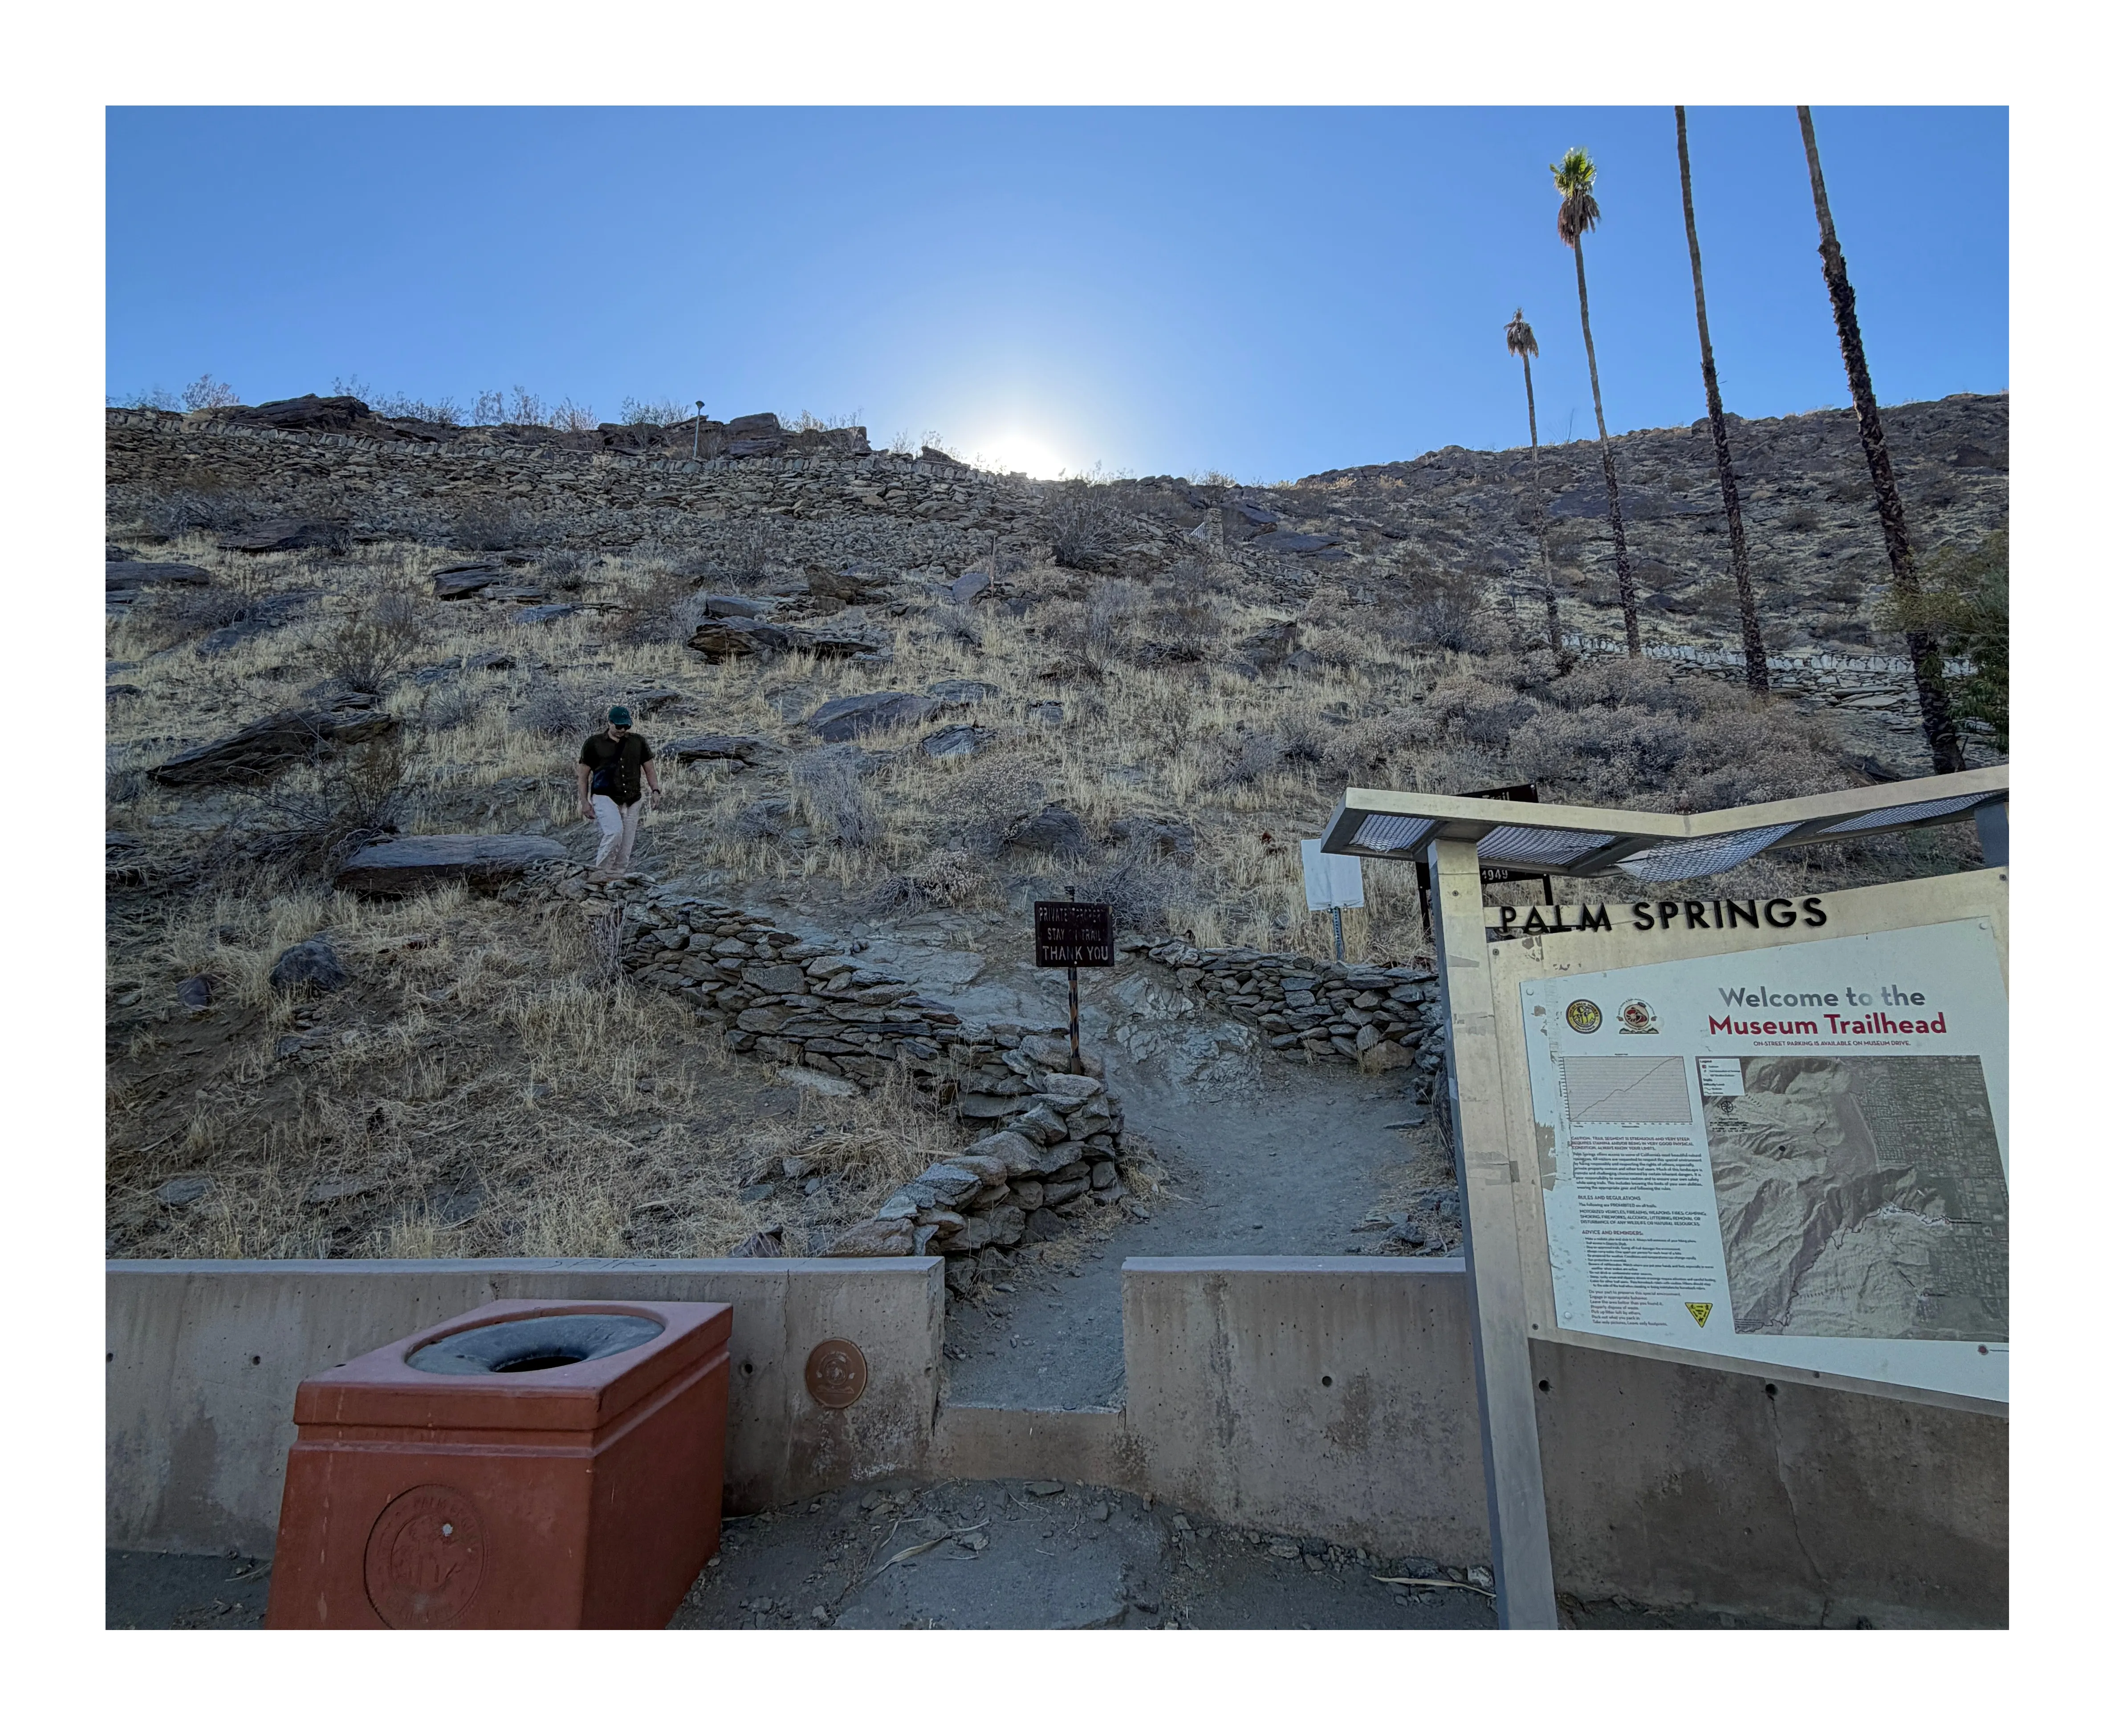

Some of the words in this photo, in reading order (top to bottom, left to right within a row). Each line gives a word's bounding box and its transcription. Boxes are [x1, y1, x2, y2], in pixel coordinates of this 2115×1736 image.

[1039, 907, 1069, 922] PRIVATE
[1500, 903, 1612, 934] PALM
[1633, 897, 1827, 931] SPRINGS
[1047, 927, 1065, 940] STAY
[1081, 928, 1102, 941] TRAIL
[1042, 945, 1083, 961] THANK
[1086, 945, 1109, 960] YOU
[1718, 986, 1839, 1008] Welcome
[1846, 987, 1873, 1006] to
[1881, 984, 1925, 1006] the
[1708, 1014, 1818, 1035] Museum
[1823, 1012, 1947, 1034] Trailhead
